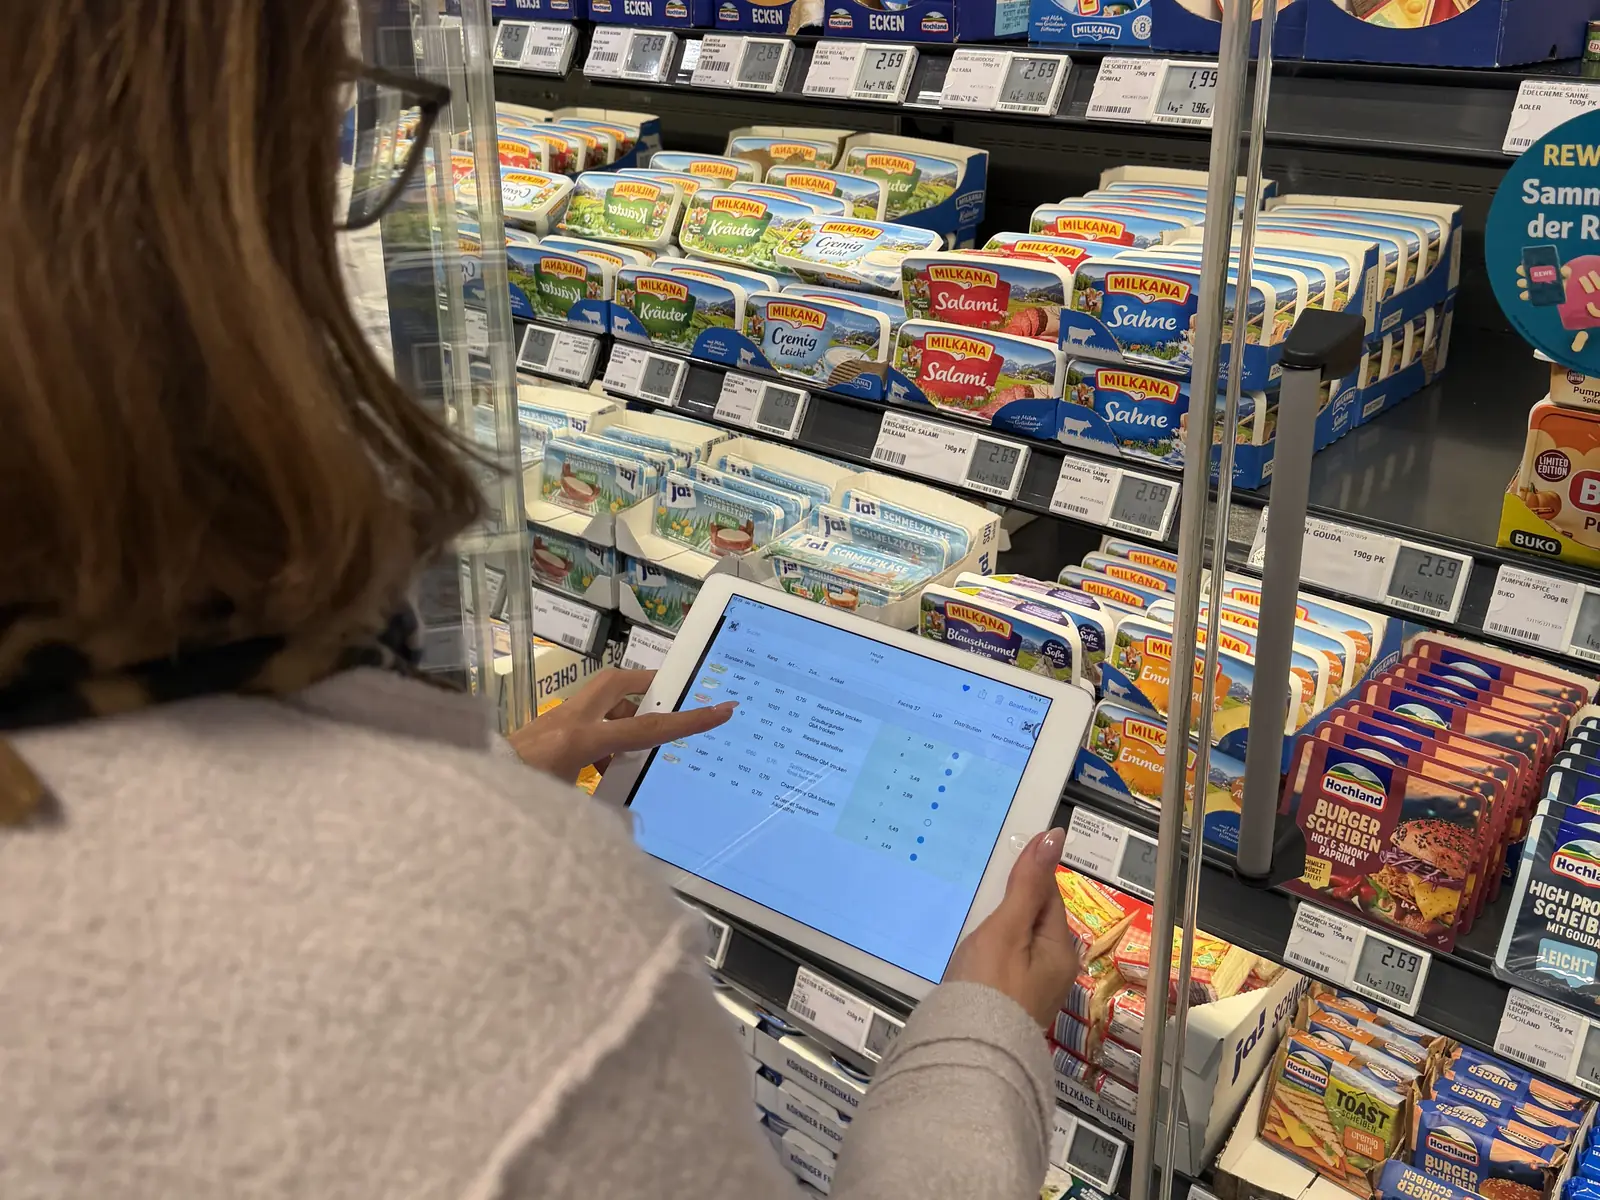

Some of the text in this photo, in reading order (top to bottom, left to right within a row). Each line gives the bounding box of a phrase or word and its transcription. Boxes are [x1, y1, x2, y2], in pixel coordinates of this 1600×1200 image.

[624, 0, 653, 17] ECKEN
[666, 9, 687, 17] Hochland
[719, 12, 739, 20] Hochland
[752, 8, 783, 25] ECKEN
[829, 18, 852, 27] Hochland
[869, 14, 905, 32] ECKEN
[921, 20, 949, 32] Hochland
[1077, 26, 1116, 36] MILKANA
[1139, 23, 1147, 33] 8
[875, 52, 904, 70] 2.69
[1024, 61, 1056, 80] 2.69
[1188, 71, 1218, 90] 1.99
[1522, 89, 1564, 98] EDELCREME
[1569, 98, 1586, 107] 100g
[870, 156, 913, 172] MILKANA
[1543, 143, 1600, 167] REW
[789, 176, 832, 192] MILKANA
[1521, 177, 1600, 206] Samm
[716, 198, 763, 216] MILKANA
[708, 219, 761, 238] Kräuter
[828, 223, 875, 238] MILKANA
[1062, 219, 1118, 236] MILKANA
[1527, 212, 1573, 239] der
[815, 236, 864, 252] Cremig
[819, 247, 847, 258] Leicht
[1020, 242, 1077, 257] MILKANA
[934, 267, 993, 286] MILKANA
[1533, 268, 1553, 278] REWE
[640, 280, 684, 298] MILKANA
[1113, 276, 1182, 299] MILKANA
[934, 291, 998, 314] Salami
[639, 302, 688, 323] Kräuter
[772, 305, 820, 326] MILKANA
[1106, 303, 1178, 331] Sahne
[771, 326, 818, 352] Cremig
[930, 336, 987, 356] MILKANA
[779, 342, 807, 359] Leicht
[923, 362, 988, 388] Salami
[1104, 375, 1171, 398] MILKANA
[1102, 401, 1170, 429] Sahne
[882, 428, 906, 439] MILKANA
[917, 428, 940, 439] SALAMI
[944, 443, 967, 455] 190g PK
[989, 445, 1018, 465] 2.69
[1537, 465, 1569, 477] EDITION
[1539, 456, 1569, 468] LIMITED
[1135, 482, 1168, 502] 2.69
[823, 514, 847, 538] ja!
[1313, 529, 1342, 543] GOUDA
[1514, 533, 1557, 553] BUKO
[1133, 553, 1176, 572] MILKAN
[1353, 549, 1386, 564] 190g PK
[1417, 555, 1458, 579] 2.69
[1111, 568, 1161, 590] MILKANA
[1500, 576, 1531, 589] PUMPKIN
[1531, 583, 1551, 593] SPICE
[1084, 582, 1137, 606] MILKANA
[1497, 589, 1515, 599] BUKO
[1543, 592, 1559, 603] 200g
[951, 604, 1005, 633] MILKANA
[946, 627, 1016, 658] Blauschimmel
[1079, 631, 1098, 642] Soße
[1044, 647, 1065, 659] Soße
[733, 672, 746, 682] Lager
[830, 676, 845, 685] Artikel
[726, 687, 739, 697] Lager
[774, 687, 785, 696] 1011
[816, 702, 863, 724] Riesling QbA trocken
[932, 711, 943, 720] LVP
[1008, 700, 1039, 716] Bearbeiten
[808, 721, 836, 736] QbA trocken
[810, 715, 845, 732] Grauburgunder
[953, 718, 983, 734] Distribution
[753, 733, 764, 741] 1021
[802, 733, 844, 753] Riesling alkoholfrei
[695, 747, 709, 757] Lager
[688, 763, 701, 773] Lager
[794, 749, 819, 763] Dornfelder
[818, 758, 829, 767] QbA
[829, 763, 848, 774] trocken
[730, 779, 739, 788] 104
[1325, 778, 1384, 807] Hochland
[807, 792, 836, 808] QbA trocken
[1314, 798, 1382, 836] BURGER
[1305, 813, 1382, 854] SCHEIBEN
[1310, 832, 1370, 862] HOT & SMOKY
[1318, 845, 1356, 868] PAPRIKA
[1528, 879, 1600, 917] HIGH PRO
[1298, 917, 1319, 929] BURGER
[1299, 911, 1328, 926] SANDWICH
[1533, 898, 1599, 935] SCHEIB
[1296, 922, 1325, 938] HOCHLAND
[1332, 930, 1354, 943] 150g PK
[1546, 921, 1600, 949] MIT GOUDA
[1380, 945, 1418, 973] 2.69
[1508, 1005, 1530, 1017] LEICHT
[1509, 999, 1561, 1025] SANDWICH SCHB.
[1325, 1016, 1364, 1037] TOAST
[1506, 1012, 1541, 1031] HOCHLAND
[1549, 1020, 1574, 1036] 150g PK
[1231, 1006, 1268, 1086] ja!
[786, 1058, 819, 1085] KÖRNIGER
[1286, 1060, 1327, 1086] Hochland
[1467, 1063, 1519, 1092] BURGER
[1450, 1082, 1502, 1109] BURGER
[786, 1103, 819, 1130] KÖRNIGER
[1335, 1088, 1390, 1130] TOAST
[1435, 1102, 1487, 1129] BURGER
[1341, 1109, 1378, 1134] SCHEIBEN
[1351, 1130, 1379, 1151] cremig
[1355, 1142, 1373, 1156] mild
[1428, 1137, 1477, 1164] Hochland
[790, 1153, 823, 1179] KÖRNIGER
[1424, 1153, 1478, 1184] BURGER
[1402, 1168, 1453, 1198] SCHEIBEN
